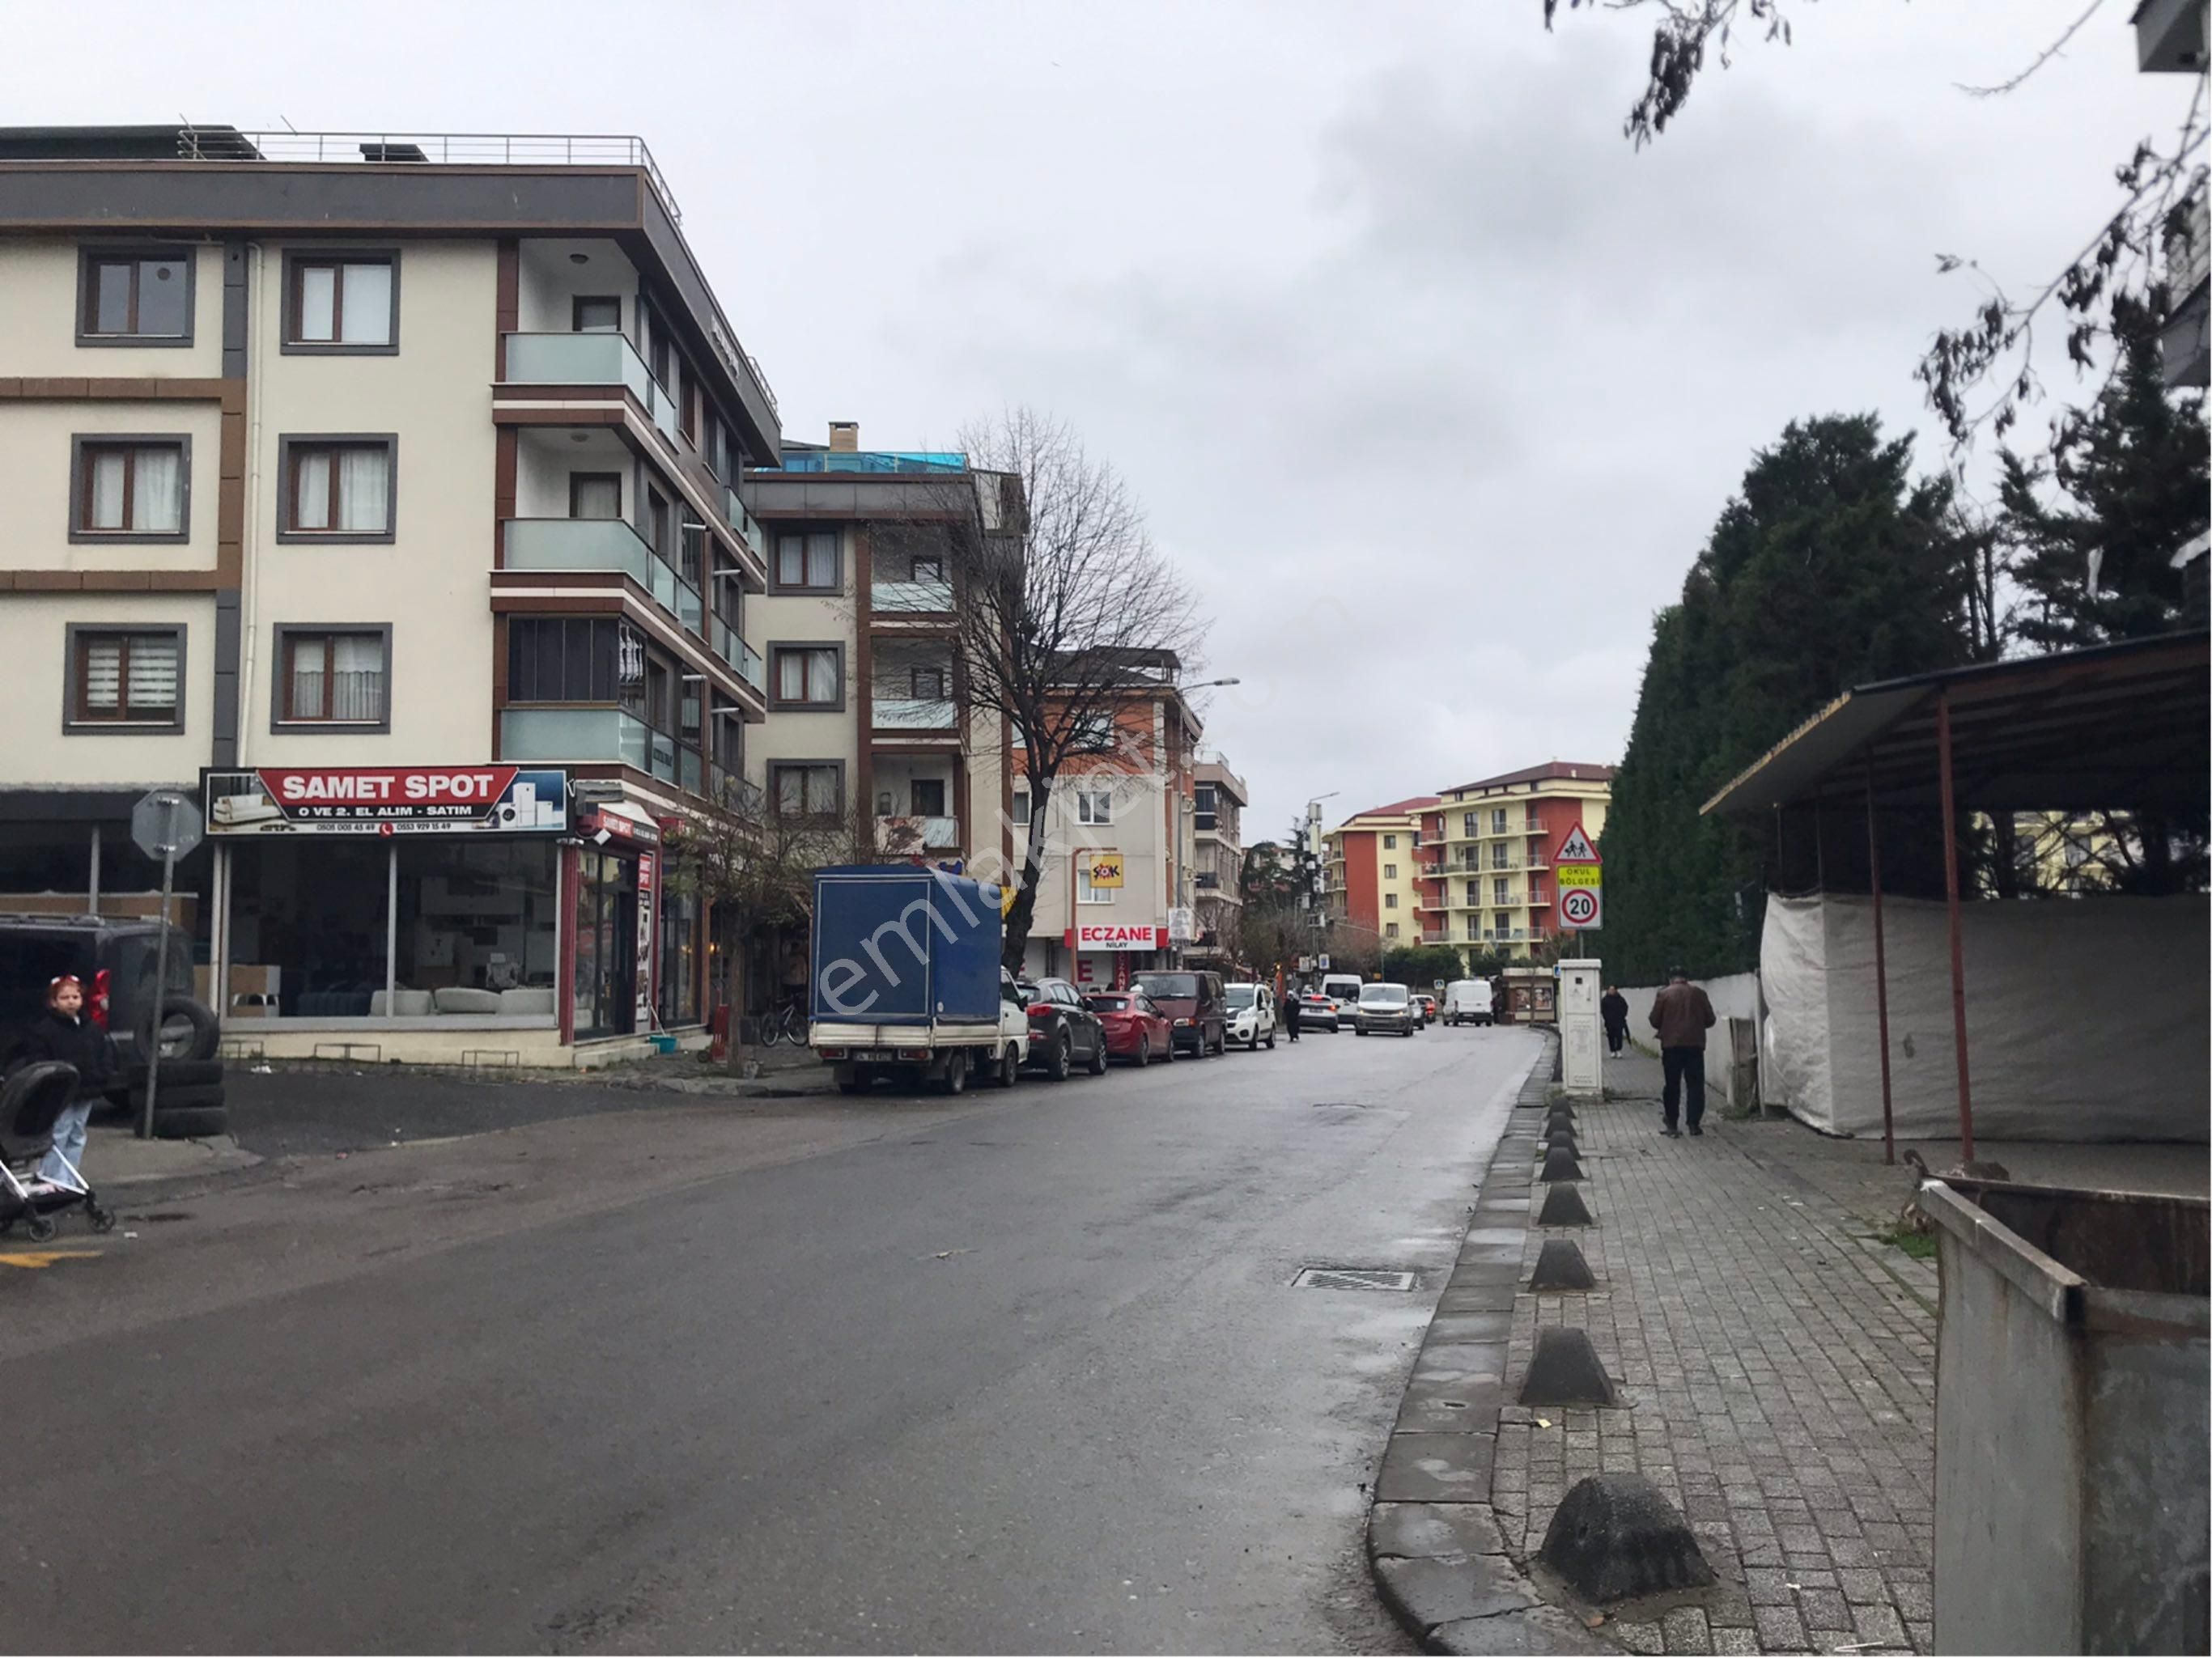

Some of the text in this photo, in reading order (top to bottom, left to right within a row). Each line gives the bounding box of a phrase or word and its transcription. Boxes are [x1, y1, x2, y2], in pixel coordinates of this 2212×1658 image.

[282, 774, 494, 799] SAMET SPOT
[313, 806, 332, 816] VE
[336, 806, 350, 816] 2.
[355, 806, 373, 816] EL
[377, 806, 412, 816] ALIM
[427, 806, 472, 816] SATIM
[1569, 898, 1591, 915] 20
[1081, 927, 1153, 941] ECZANE
